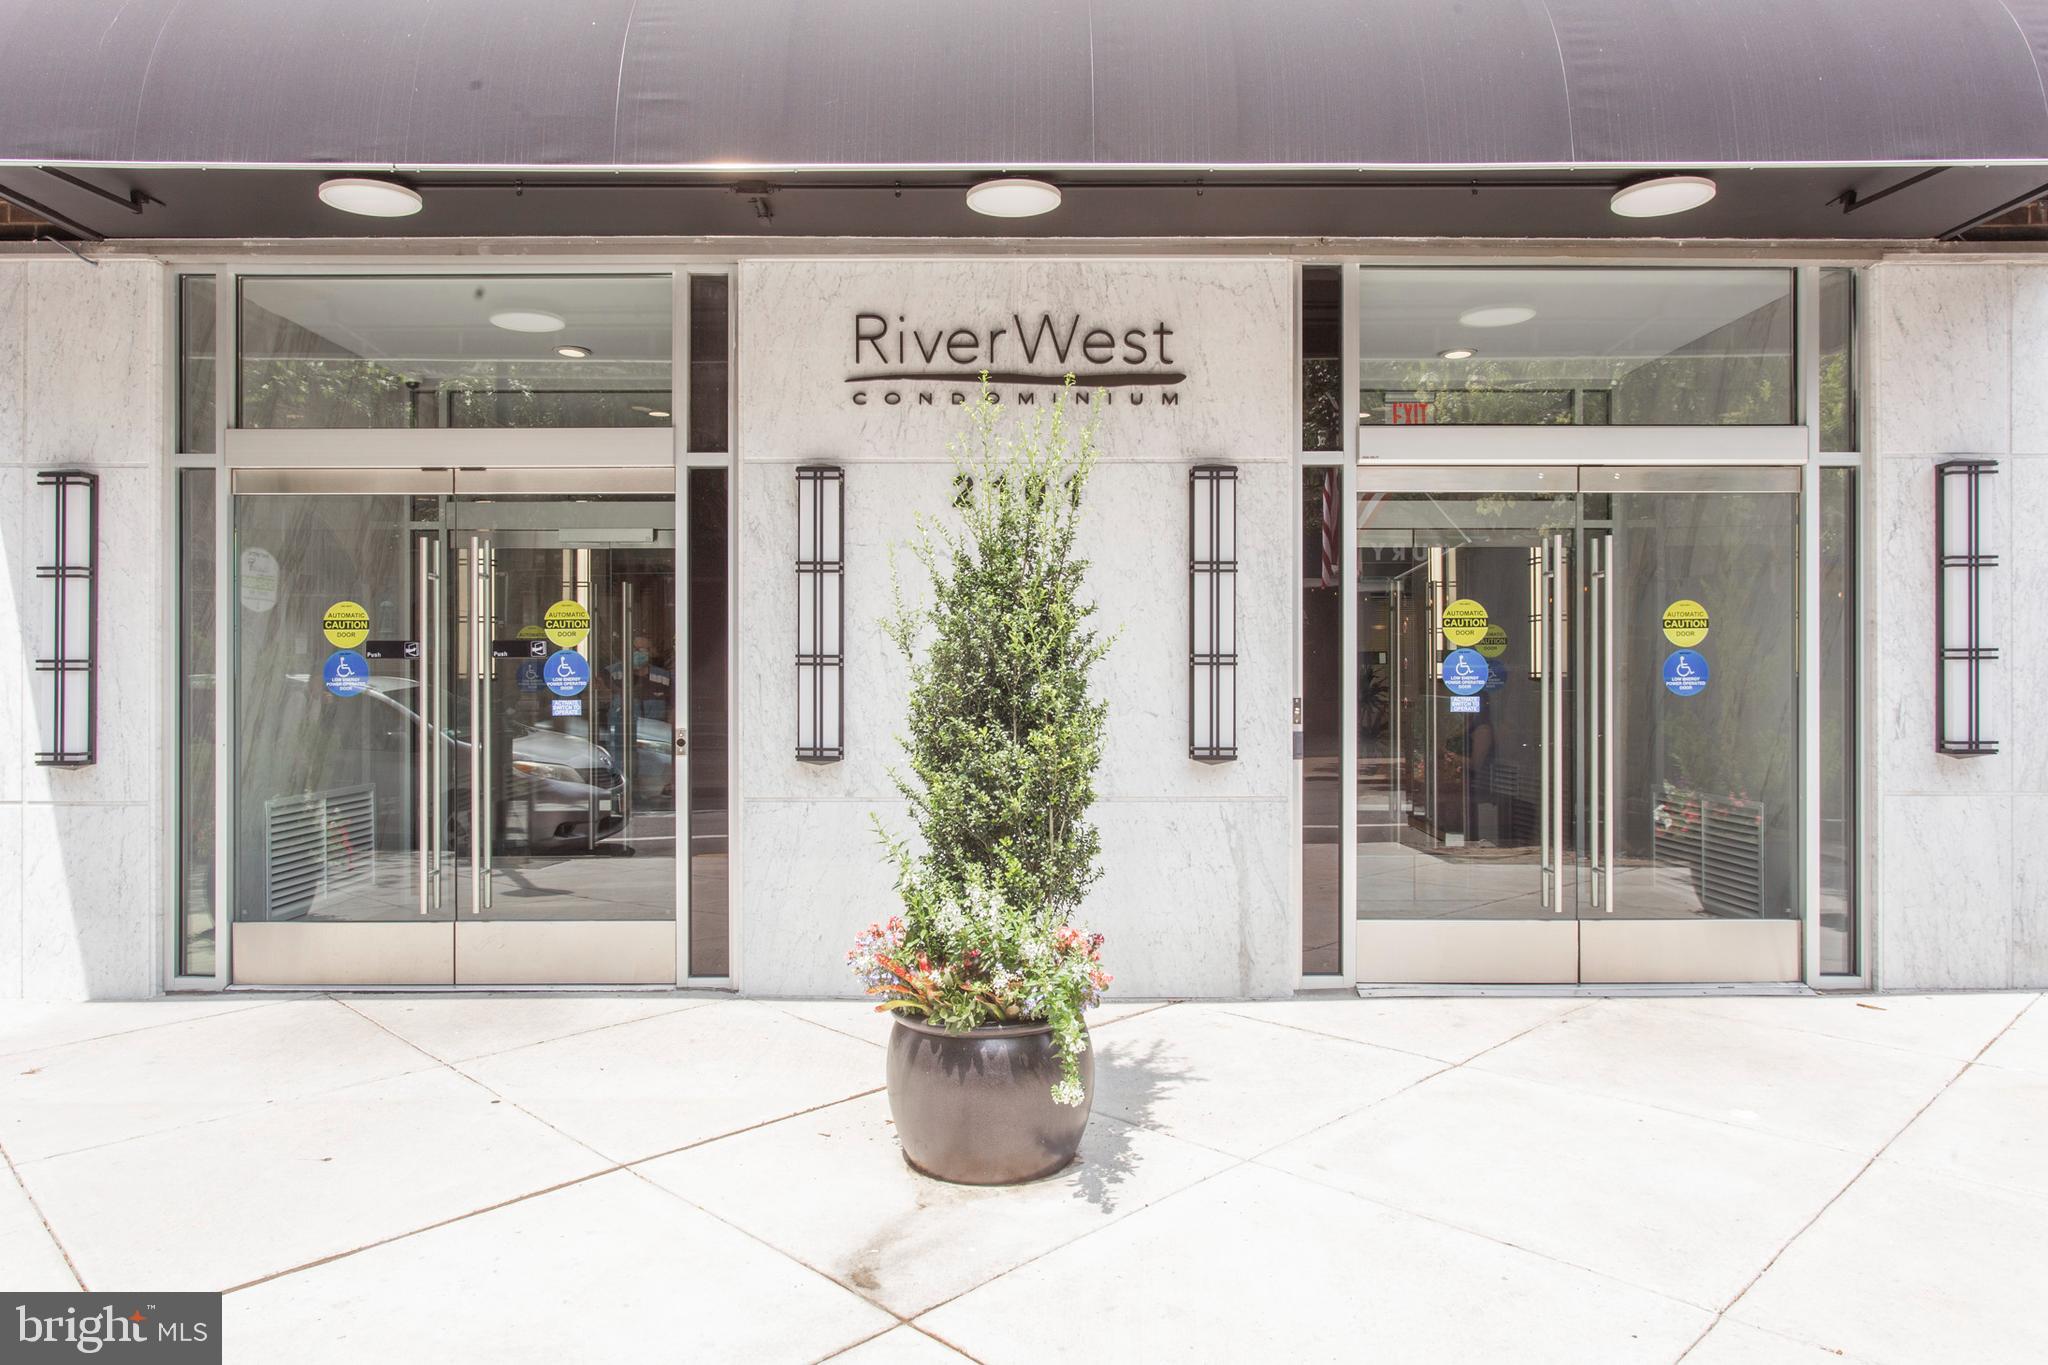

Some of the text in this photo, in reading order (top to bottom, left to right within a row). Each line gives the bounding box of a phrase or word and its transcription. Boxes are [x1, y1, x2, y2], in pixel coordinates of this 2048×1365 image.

[855, 313, 1174, 365] RiverWest
[852, 391, 1179, 406] CONDOMINIUM
[1391, 402, 1429, 425] EXIT
[324, 621, 368, 629] CAUTION
[546, 620, 588, 628] CAUTION
